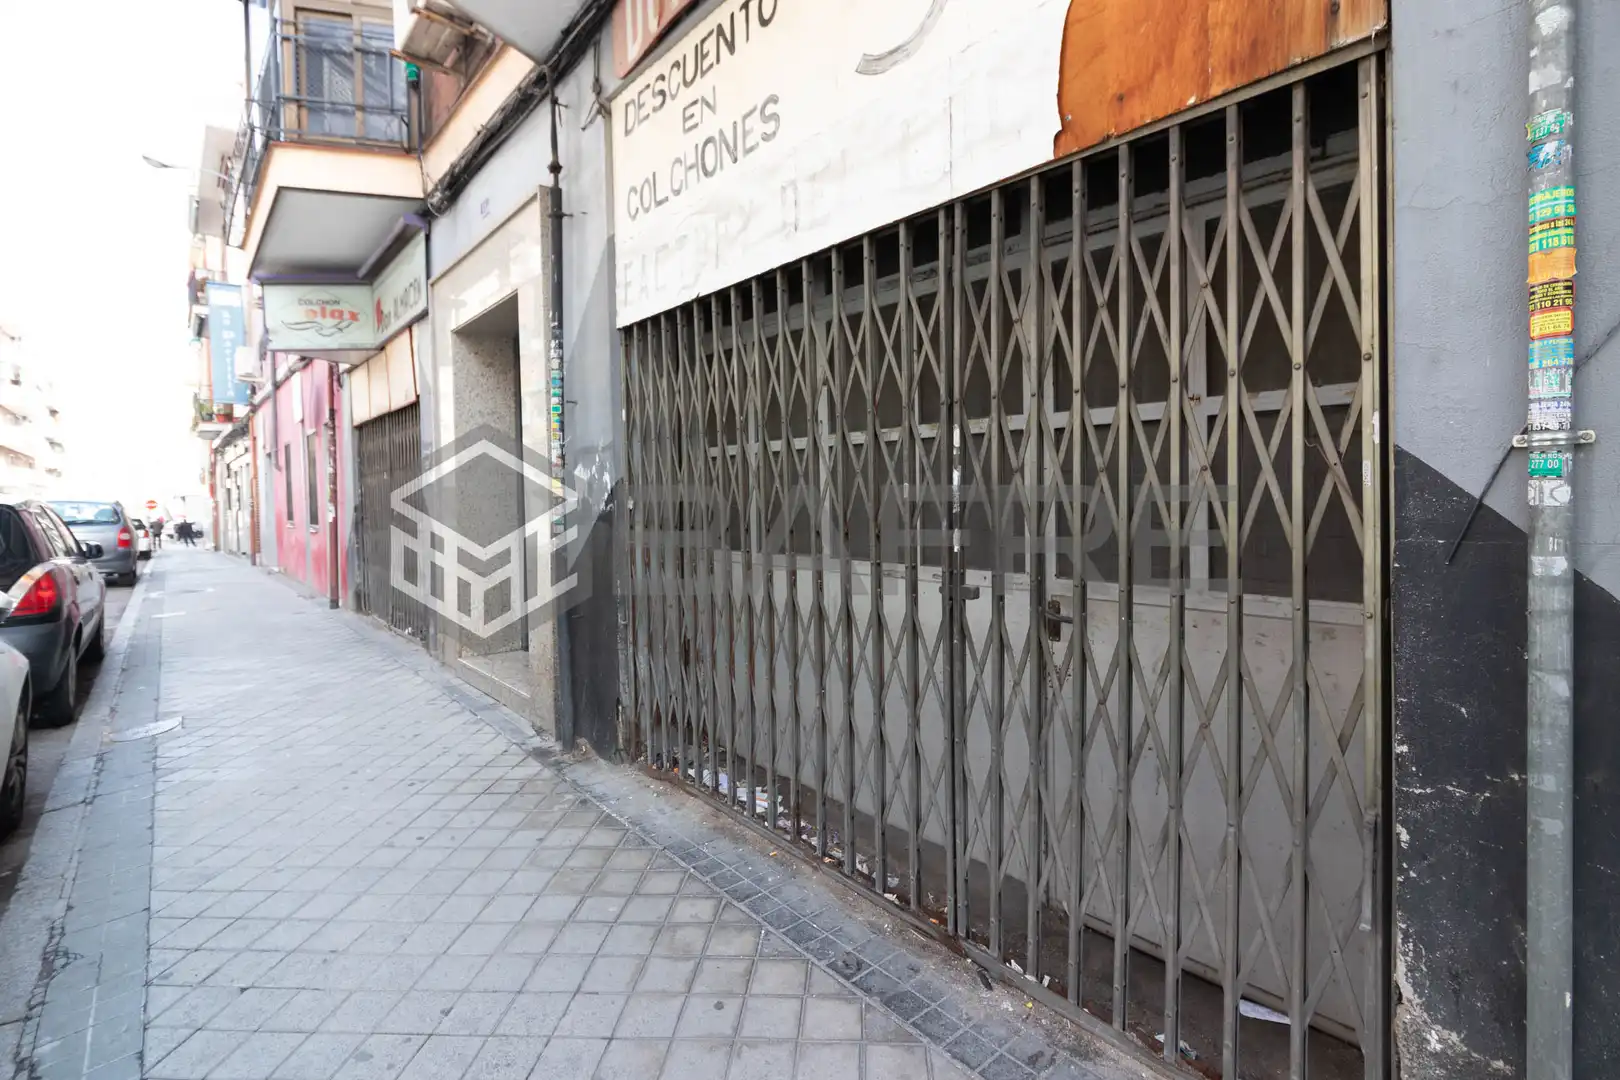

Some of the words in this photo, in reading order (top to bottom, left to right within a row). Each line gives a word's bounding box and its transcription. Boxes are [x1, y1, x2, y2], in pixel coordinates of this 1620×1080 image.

[624, 0, 778, 138] DESCUENTO
[682, 85, 717, 135] EN
[627, 93, 781, 222] COLCHONES
